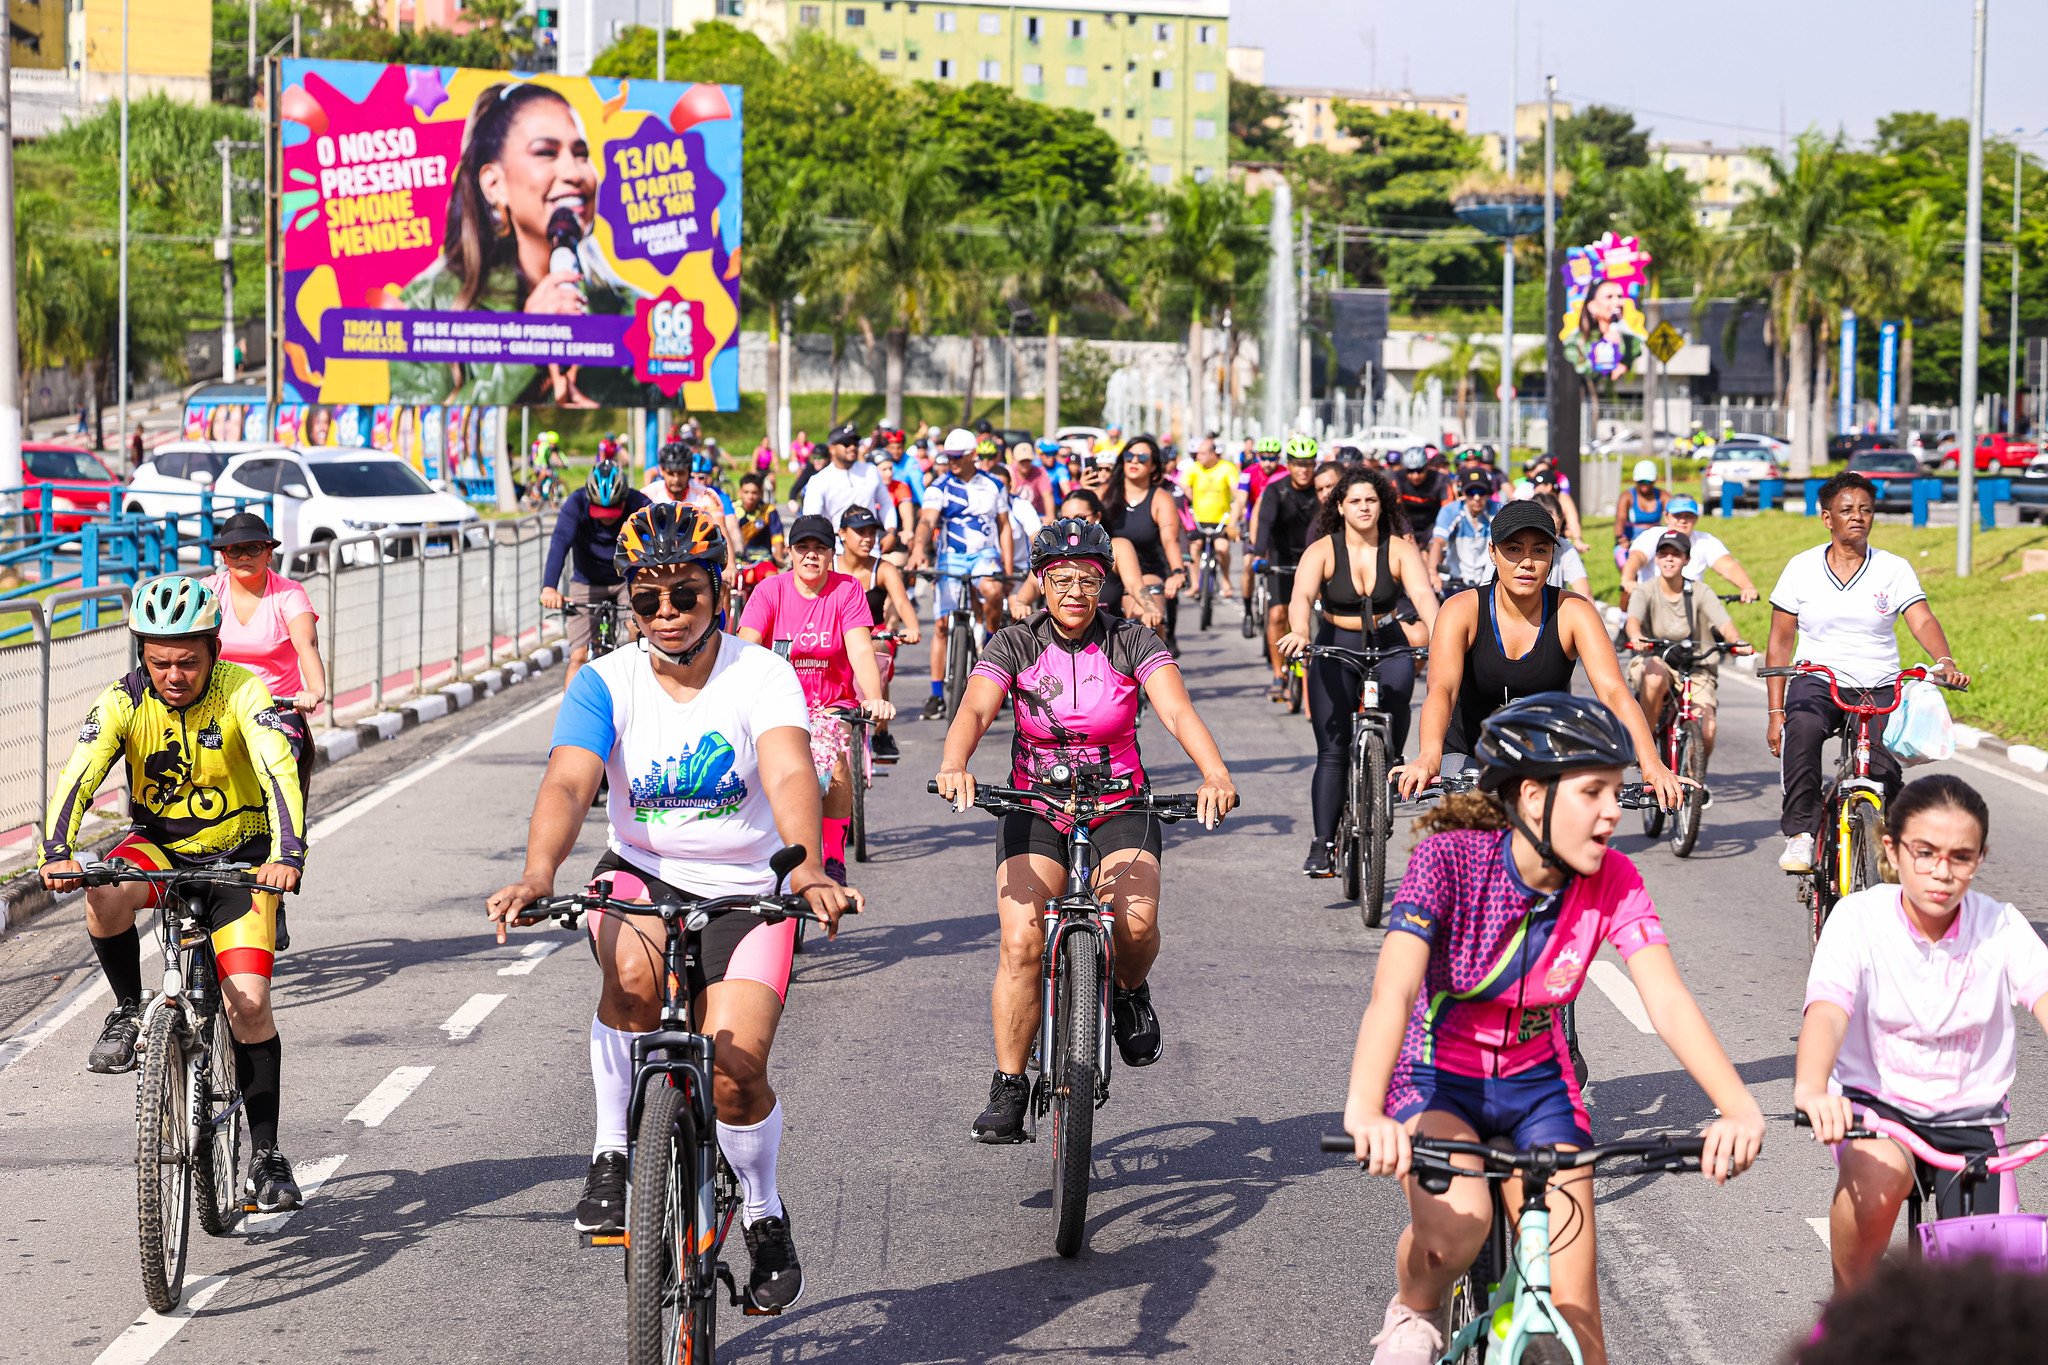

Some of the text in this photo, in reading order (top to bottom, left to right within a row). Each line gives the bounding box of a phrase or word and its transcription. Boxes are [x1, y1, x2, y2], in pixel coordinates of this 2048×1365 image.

[316, 127, 417, 167] O NOSSO
[613, 138, 688, 180] 13/04
[320, 155, 447, 199] PRESENTE?
[620, 170, 696, 204] A PARTIR
[325, 190, 415, 229] SIMONE
[626, 191, 695, 224] DAS 16H
[328, 216, 433, 259] MENDES!
[632, 217, 698, 245] PARQUE DA
[343, 319, 404, 336] TROCA DE
[652, 300, 693, 337] 66
[412, 338, 421, 353] A
[198, 733, 222, 741] POWER
[634, 807, 669, 825] 5K
[664, 799, 718, 808] RUNNING
[720, 792, 743, 806] DAY
